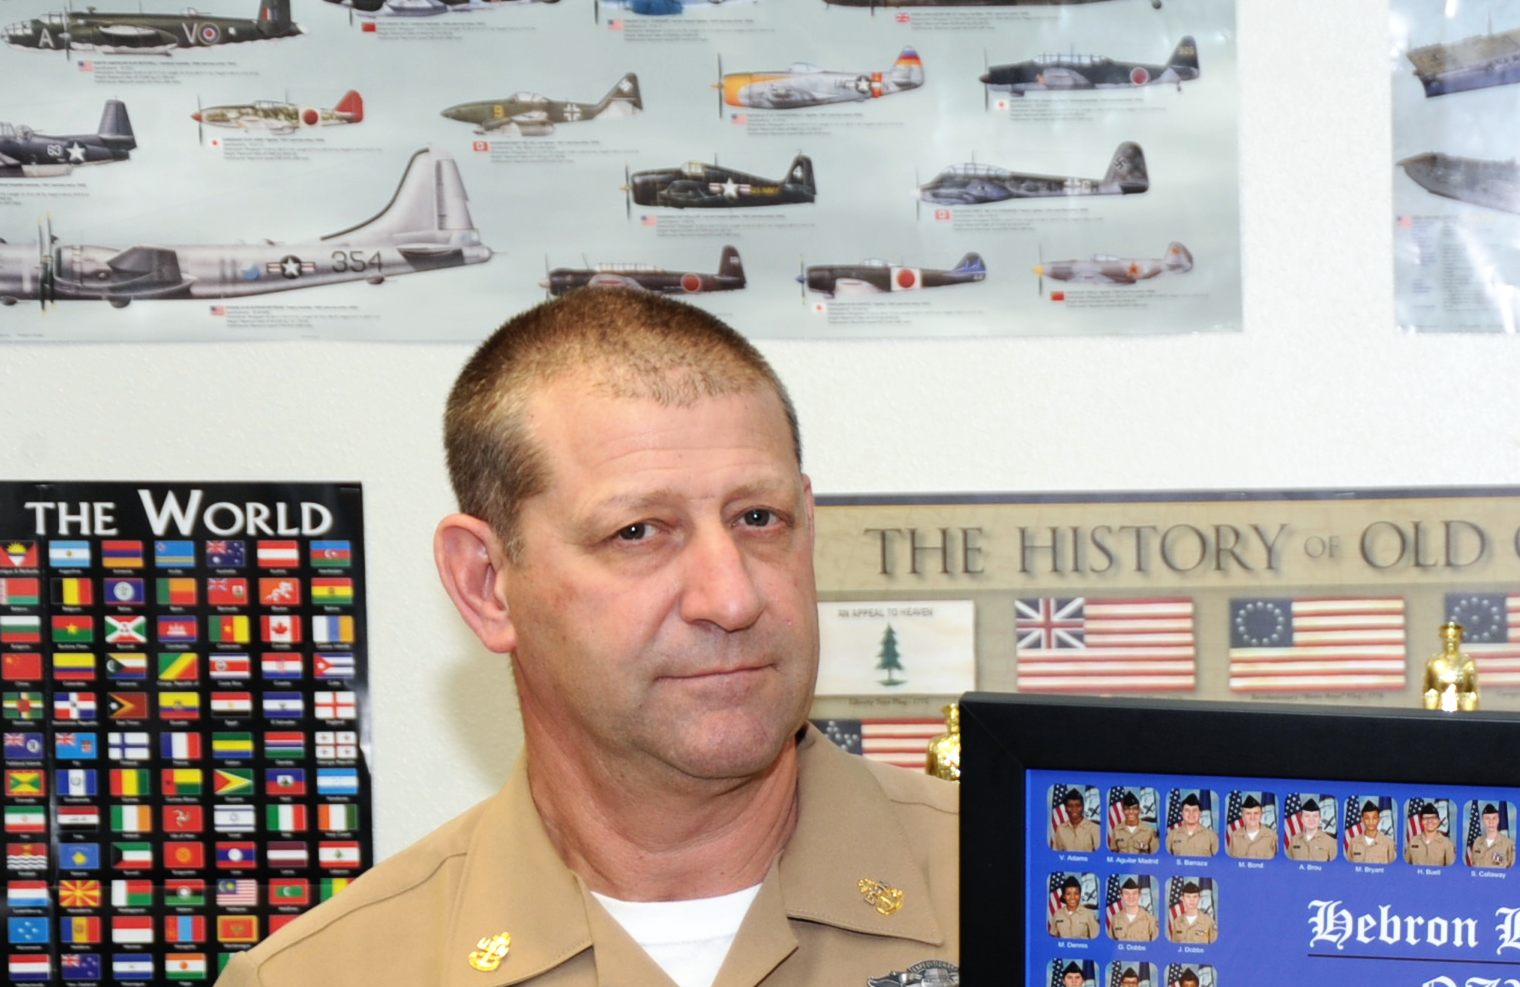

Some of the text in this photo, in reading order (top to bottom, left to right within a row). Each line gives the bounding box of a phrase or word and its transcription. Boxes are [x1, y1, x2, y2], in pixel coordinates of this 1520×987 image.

[331, 250, 381, 273] 354
[24, 489, 334, 536] THE WORLD
[864, 527, 985, 575] THE
[1017, 523, 1290, 574] HISTORY
[1304, 535, 1340, 558] OF
[1360, 520, 1488, 569] OLD
[1308, 899, 1478, 950] Hebron
